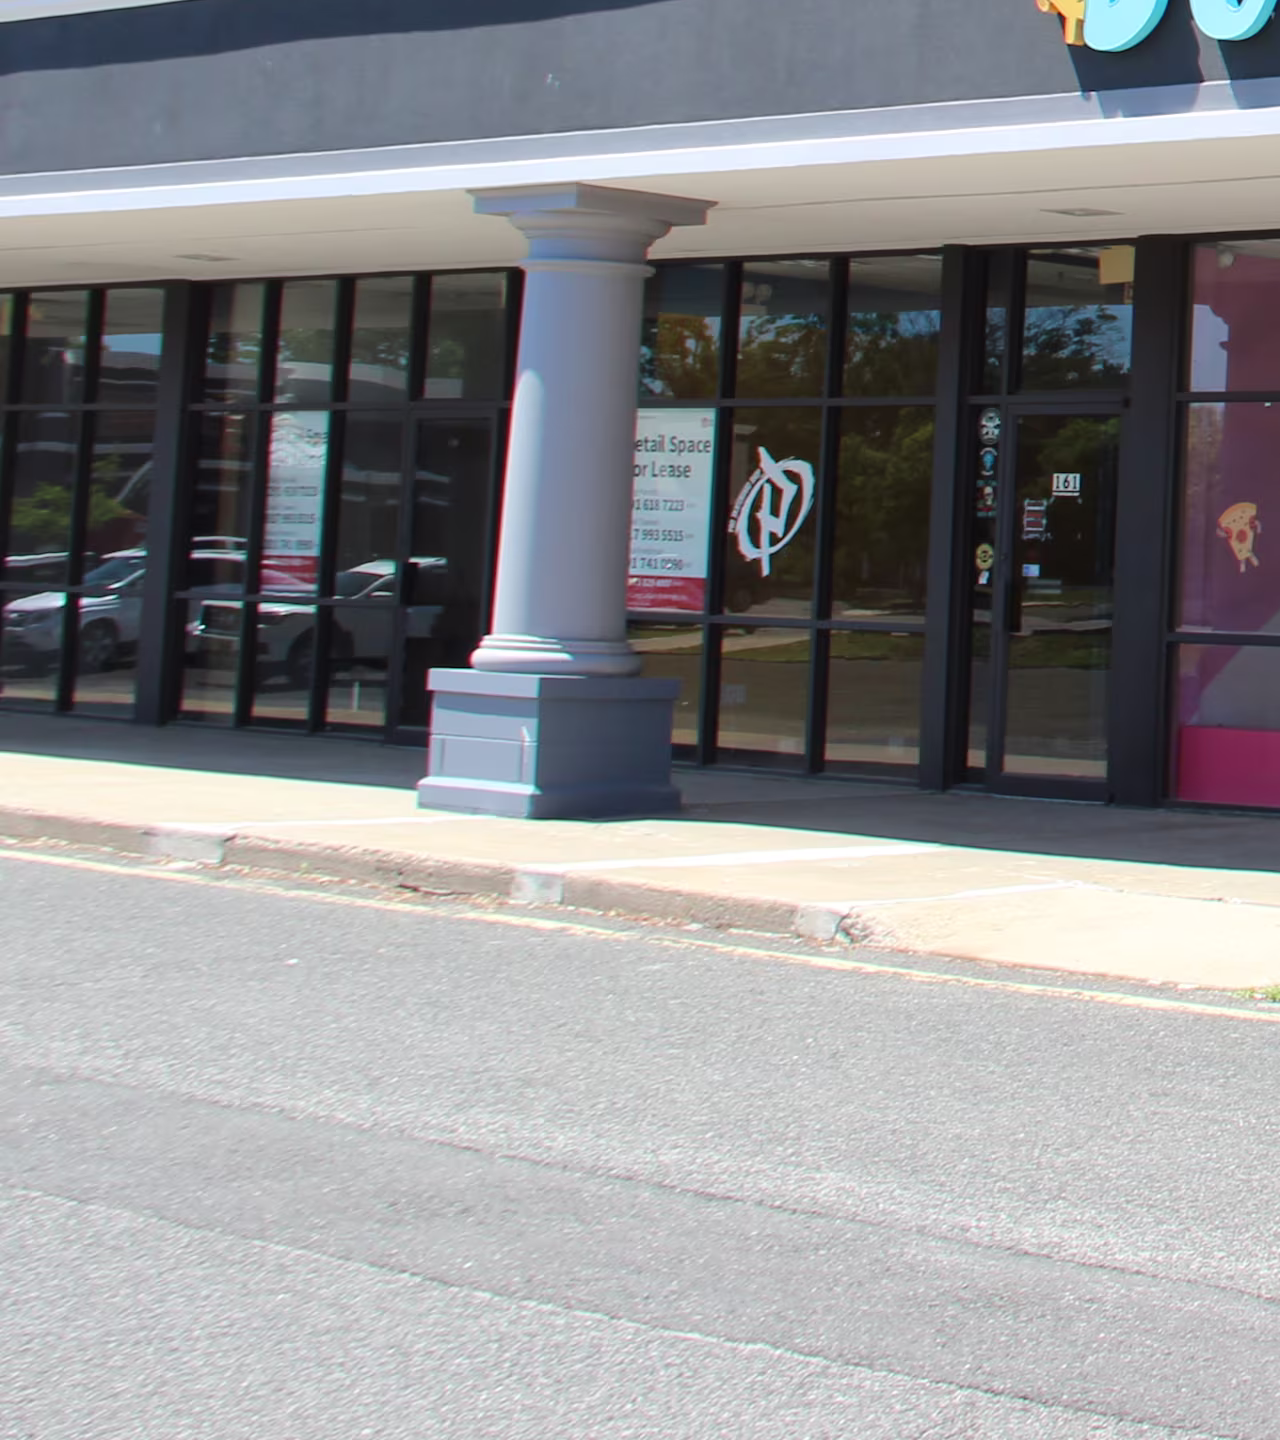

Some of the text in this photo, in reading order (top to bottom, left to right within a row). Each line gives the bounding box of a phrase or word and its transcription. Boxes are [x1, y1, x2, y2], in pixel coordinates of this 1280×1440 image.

[635, 434, 711, 456] etail Space
[633, 461, 691, 478] or Lease
[1054, 474, 1079, 491] 161
